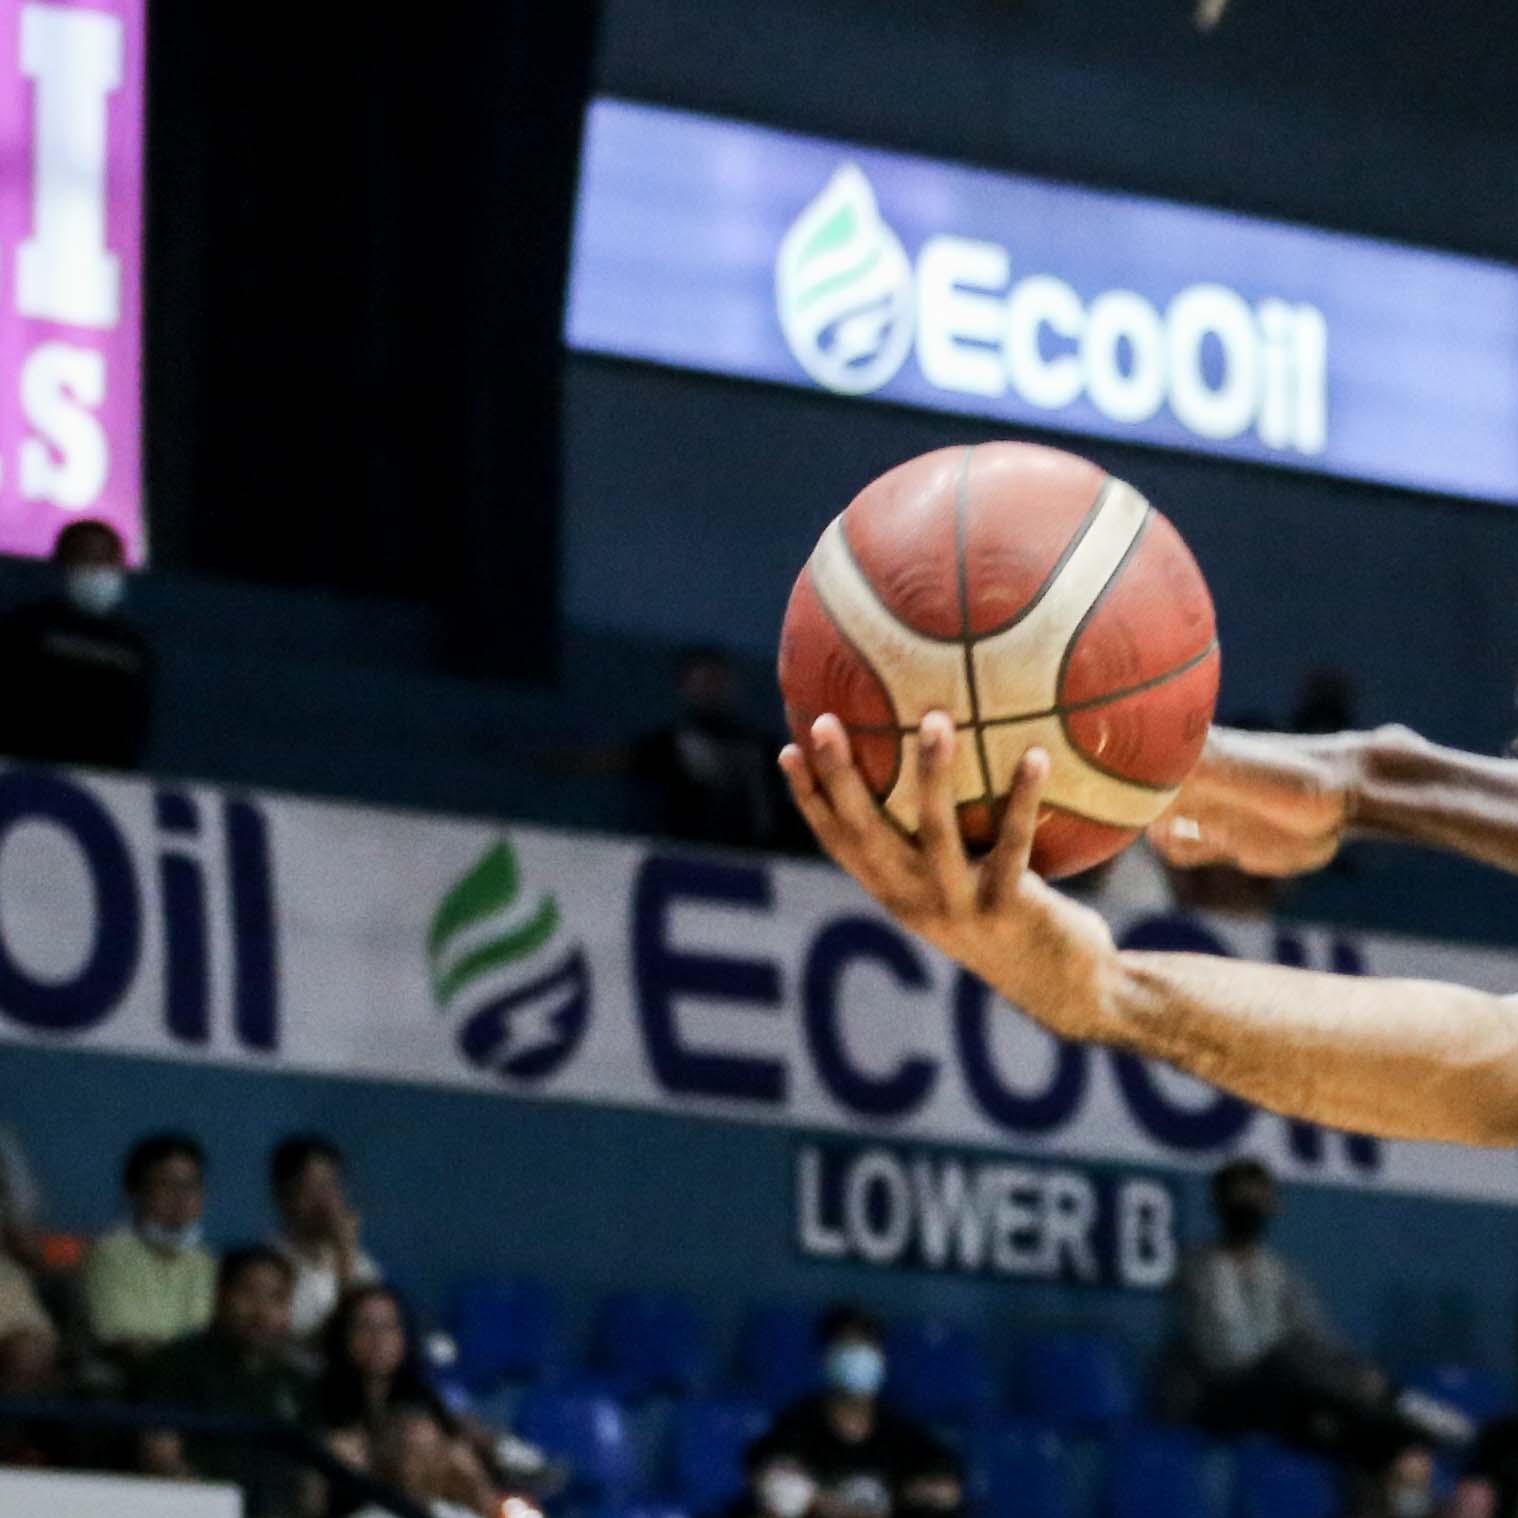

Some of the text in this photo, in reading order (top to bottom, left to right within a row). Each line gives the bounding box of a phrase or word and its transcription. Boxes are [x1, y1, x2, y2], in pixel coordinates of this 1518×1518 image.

[914, 234, 1328, 457] EcoOil
[799, 1146, 1176, 1288] LOWER B
